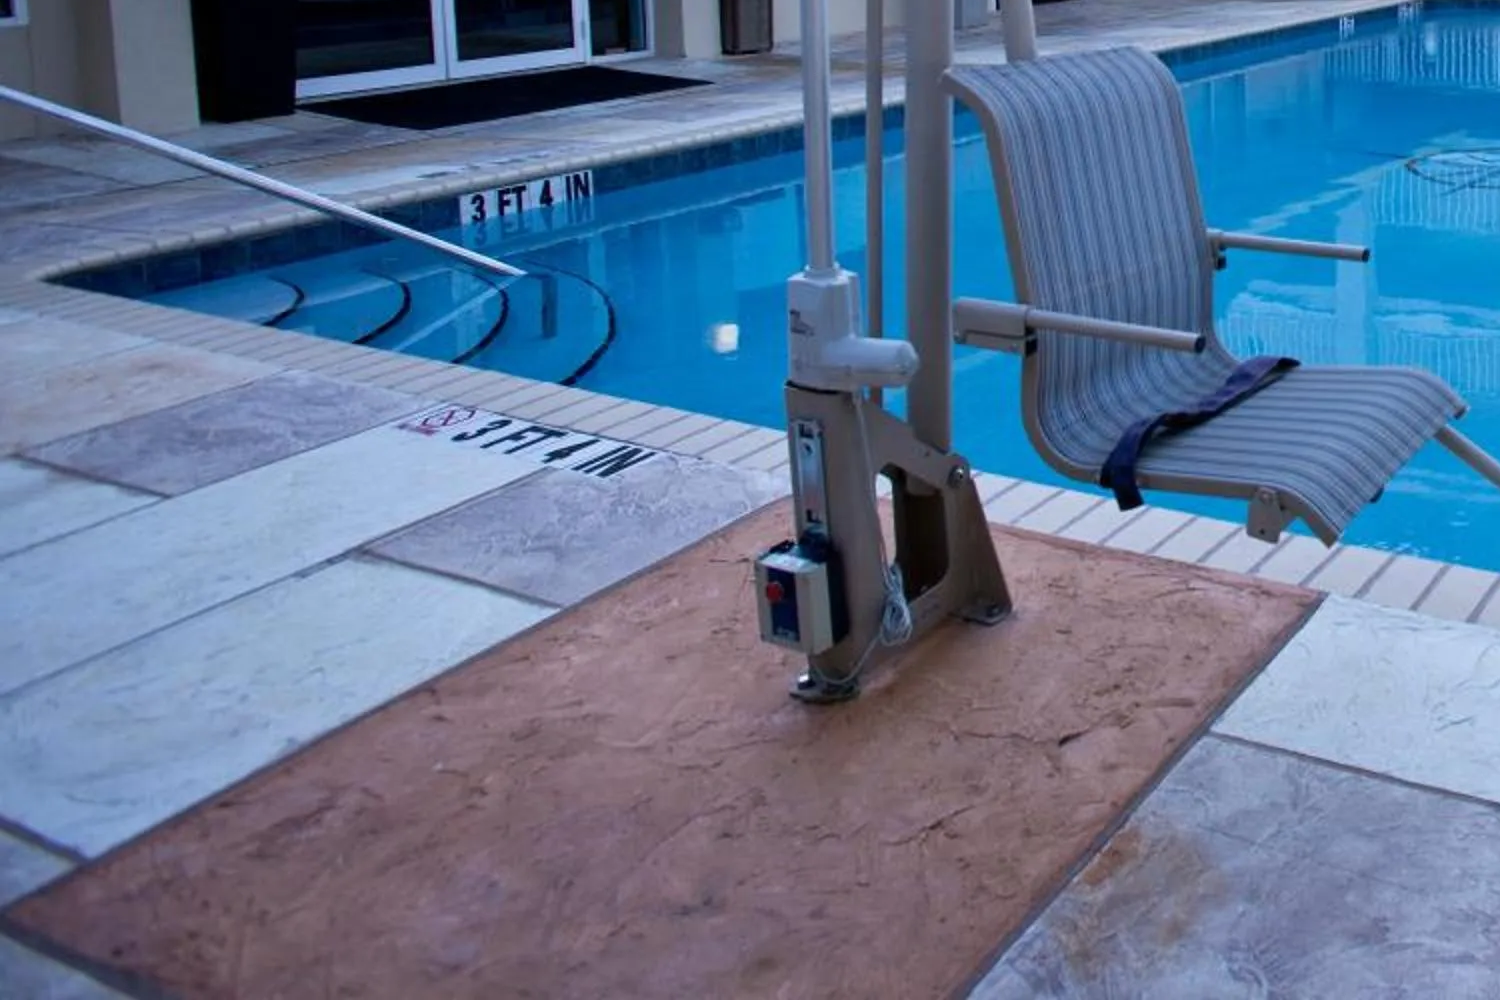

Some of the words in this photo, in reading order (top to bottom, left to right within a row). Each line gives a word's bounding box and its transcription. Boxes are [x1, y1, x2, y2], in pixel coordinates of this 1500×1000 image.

[471, 194, 486, 221] 3
[498, 185, 526, 216] FT
[540, 180, 553, 205] 4
[565, 171, 590, 201] IN
[451, 419, 512, 441] 3
[480, 425, 568, 454] FT
[542, 439, 600, 463] 4
[571, 446, 657, 477] IN
